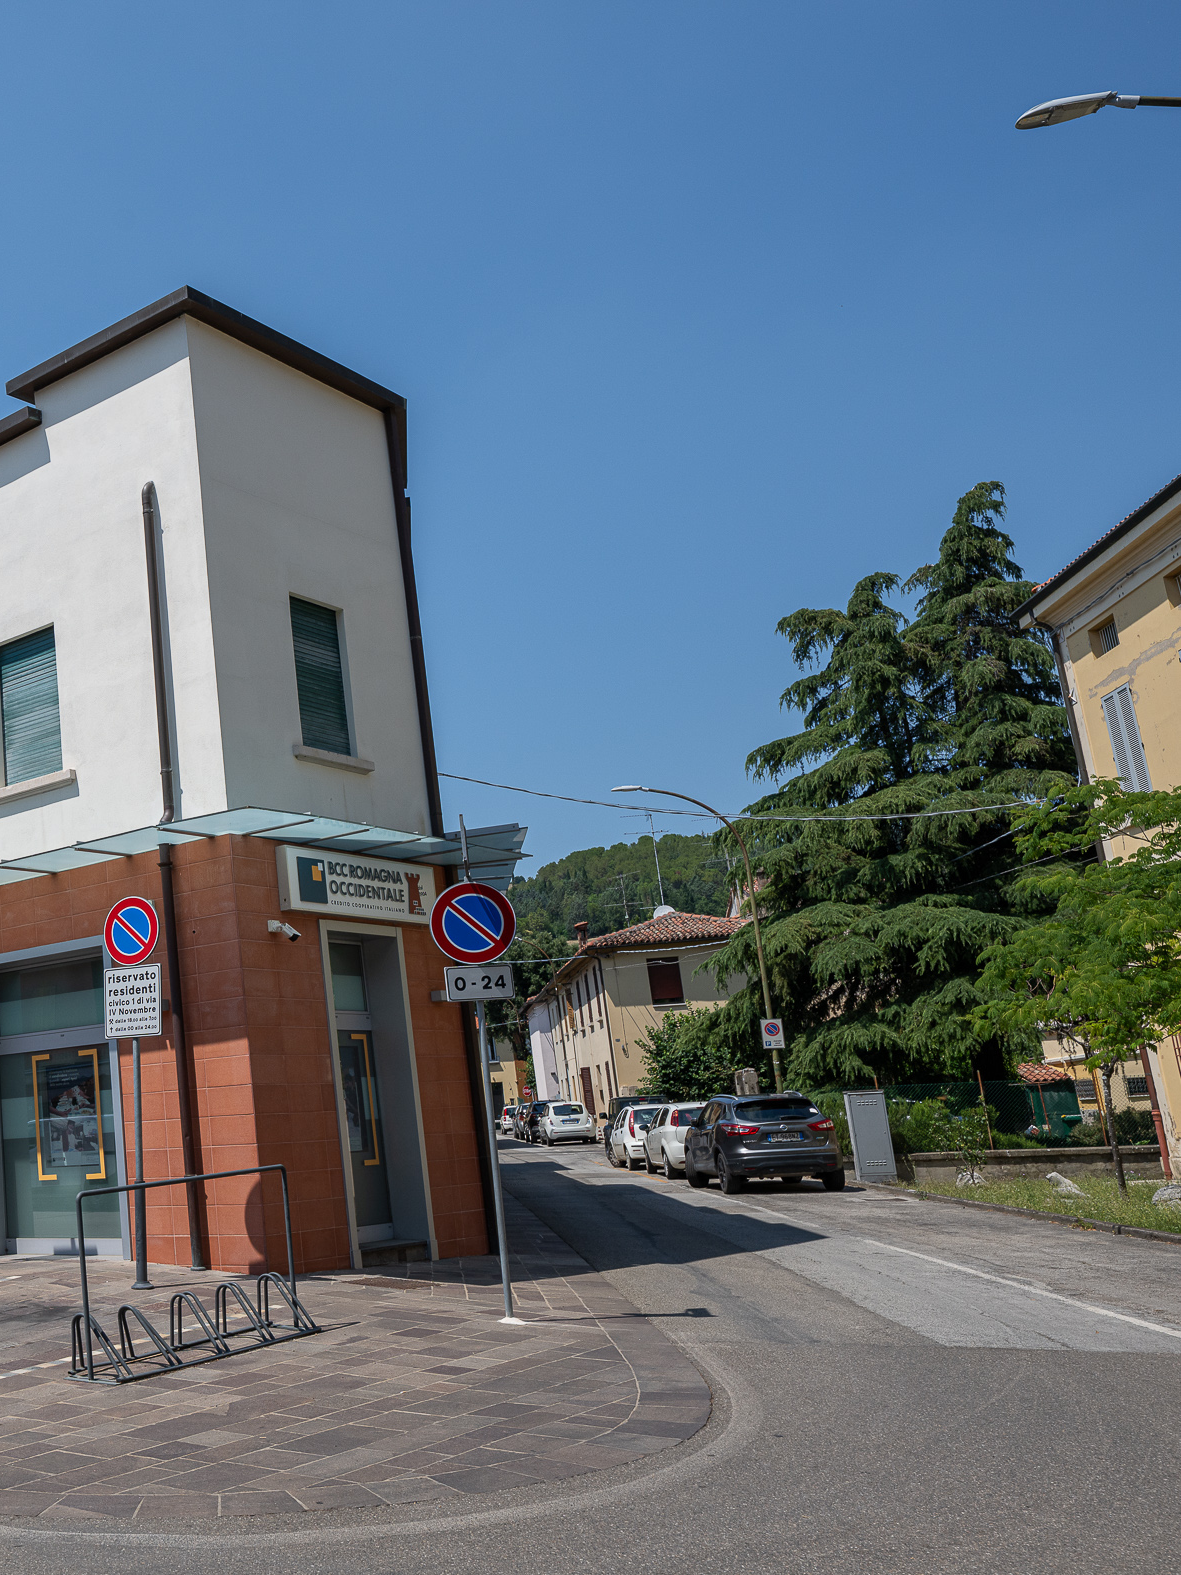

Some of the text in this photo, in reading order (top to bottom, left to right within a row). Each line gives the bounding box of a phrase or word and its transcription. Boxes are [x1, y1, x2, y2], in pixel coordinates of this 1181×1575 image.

[327, 861, 403, 885] BCC ROMAGNA
[329, 880, 405, 902] OCCIDENTALE
[108, 970, 156, 984] riservato
[481, 974, 507, 990] 24
[108, 983, 156, 997] residenti
[108, 999, 130, 1007] civico
[145, 995, 157, 1004] via
[108, 1006, 156, 1016] IV Novembre
